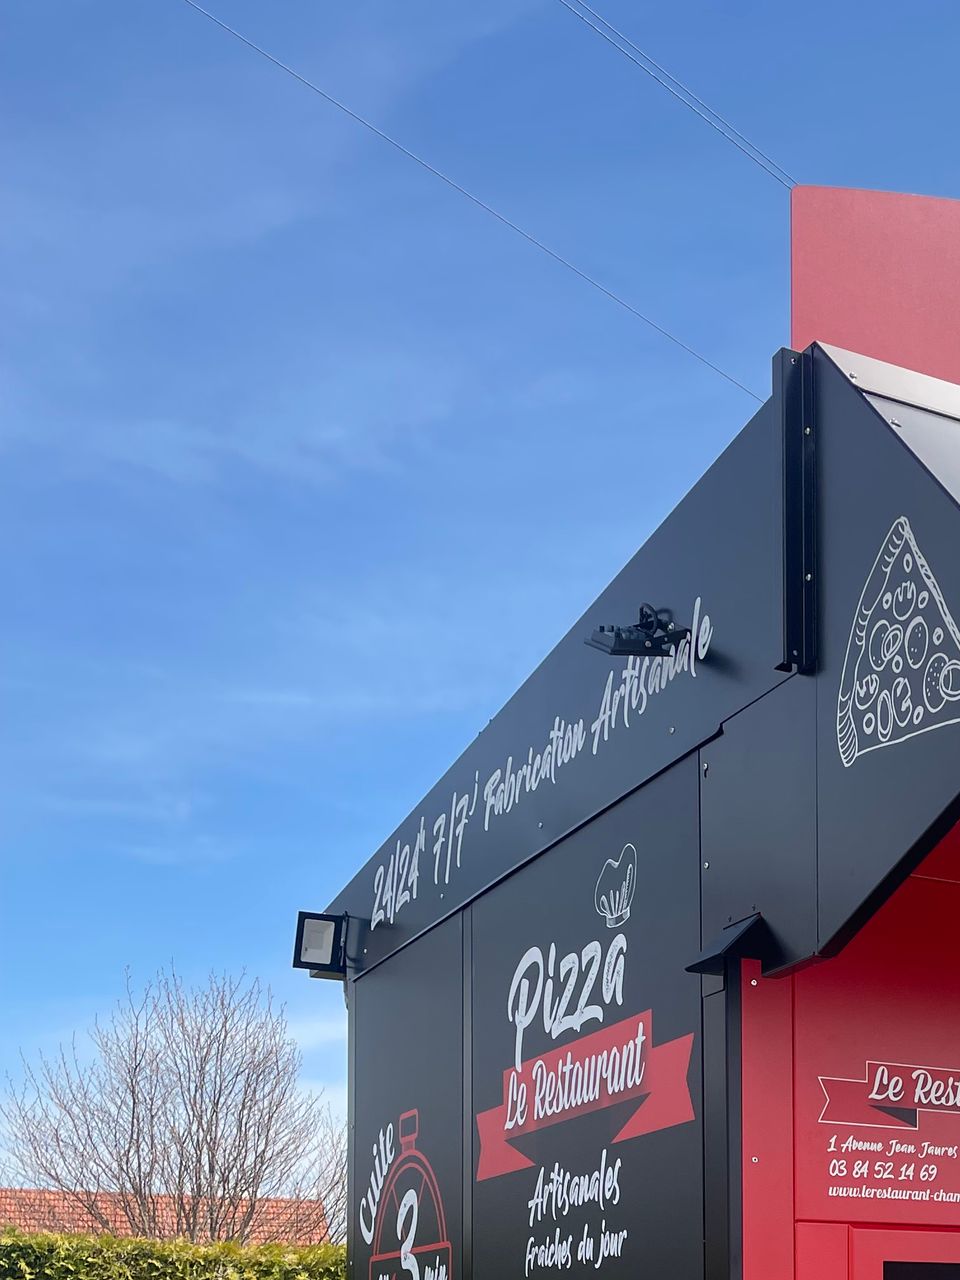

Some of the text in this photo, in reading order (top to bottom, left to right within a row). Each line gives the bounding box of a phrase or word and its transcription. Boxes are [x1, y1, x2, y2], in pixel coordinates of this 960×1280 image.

[483, 716, 587, 832] Fabrication
[591, 596, 714, 756] Artisanale
[507, 933, 627, 1073] Pizza
[504, 1021, 647, 1131] Le Restaurant
[868, 1065, 904, 1102] Le
[359, 1122, 395, 1246] Cuite
[827, 1134, 838, 1153] 1
[840, 1135, 884, 1154] Avenue
[885, 1138, 917, 1159] Jean
[918, 1140, 959, 1160] Jaures
[828, 1158, 938, 1182] 03 84 52 14 69
[527, 1148, 623, 1228] Artisanales
[577, 1222, 595, 1269] du
[595, 1217, 628, 1269] jour
